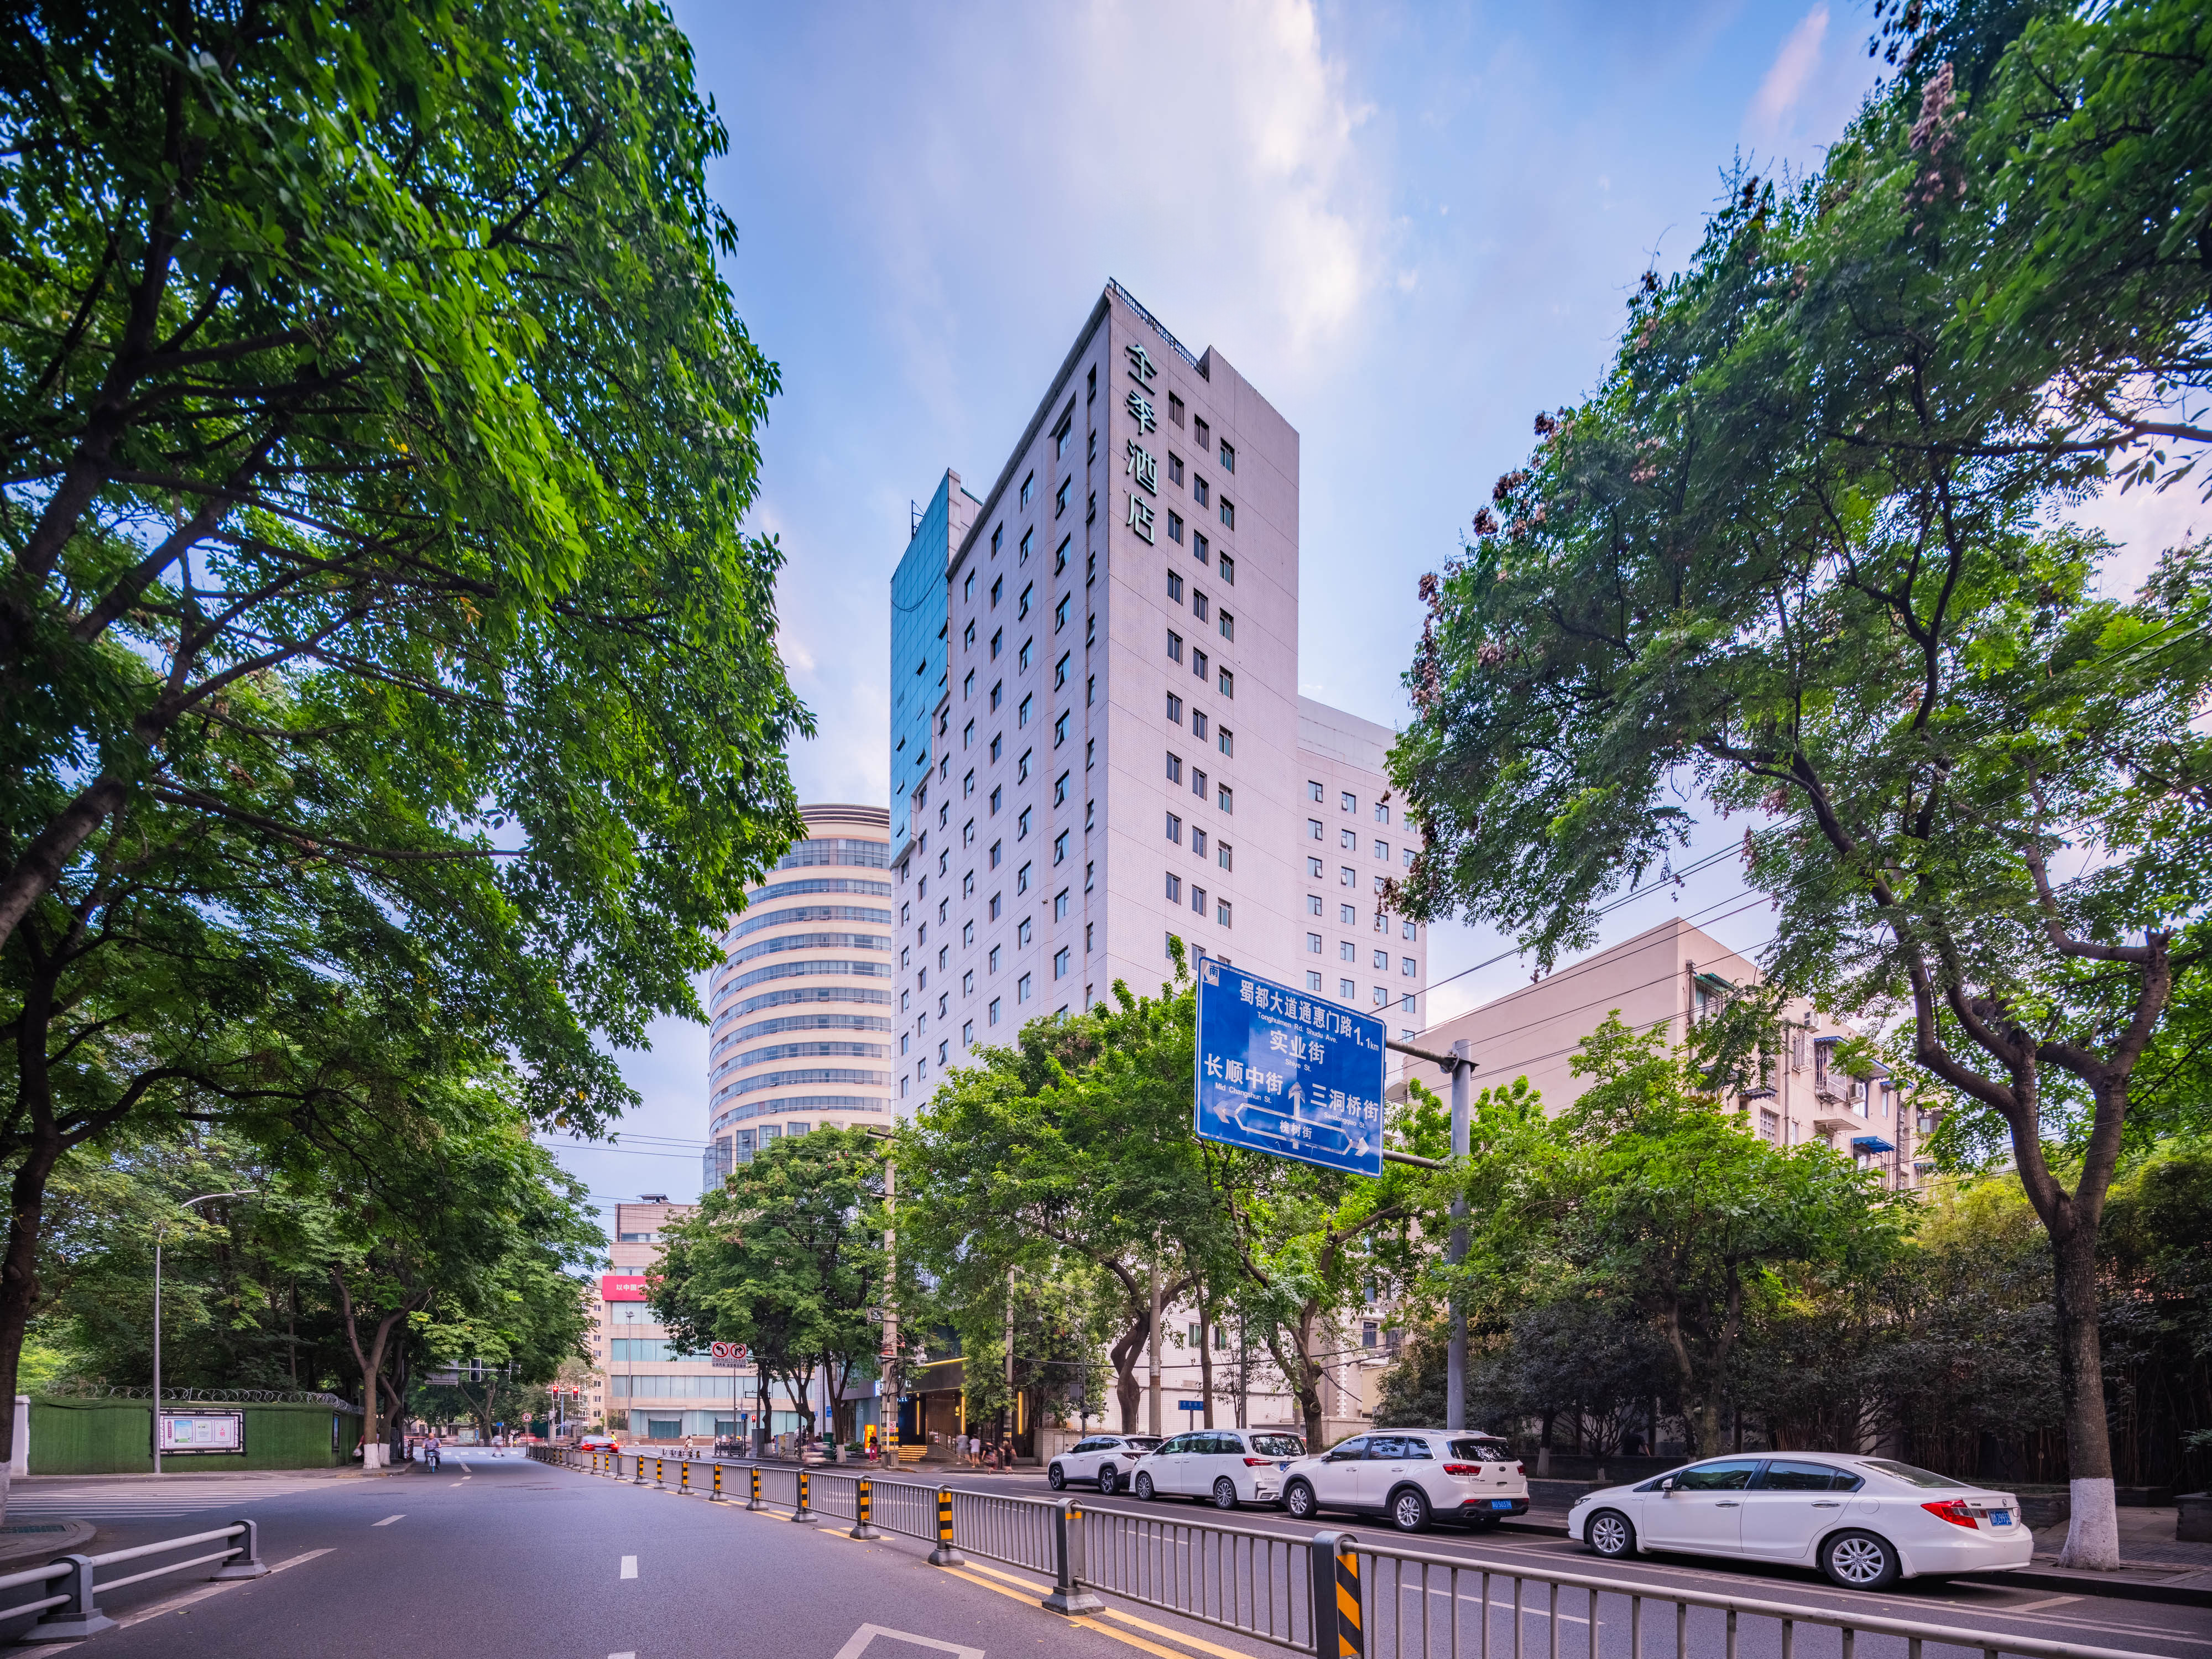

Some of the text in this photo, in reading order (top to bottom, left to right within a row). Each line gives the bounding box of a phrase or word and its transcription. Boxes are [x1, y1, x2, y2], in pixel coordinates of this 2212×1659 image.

[1126, 344, 1157, 546] 全季酒店
[1209, 965, 1219, 977] 南
[1239, 979, 1353, 1038] 蜀都大道通惠门路
[1257, 1011, 1338, 1044] Tonghuimen Rd. Shudu Ave.
[1270, 1030, 1324, 1065] 实业街
[1285, 1058, 1301, 1070] Shiye
[1204, 1053, 1283, 1095] 长顺中街
[1215, 1082, 1226, 1091] Mid
[1229, 1086, 1261, 1101] Changshun
[1311, 1083, 1379, 1122] 三洞桥街
[1279, 1120, 1312, 1140] 槐树街
[1324, 1112, 1357, 1126] Sandongqiao
